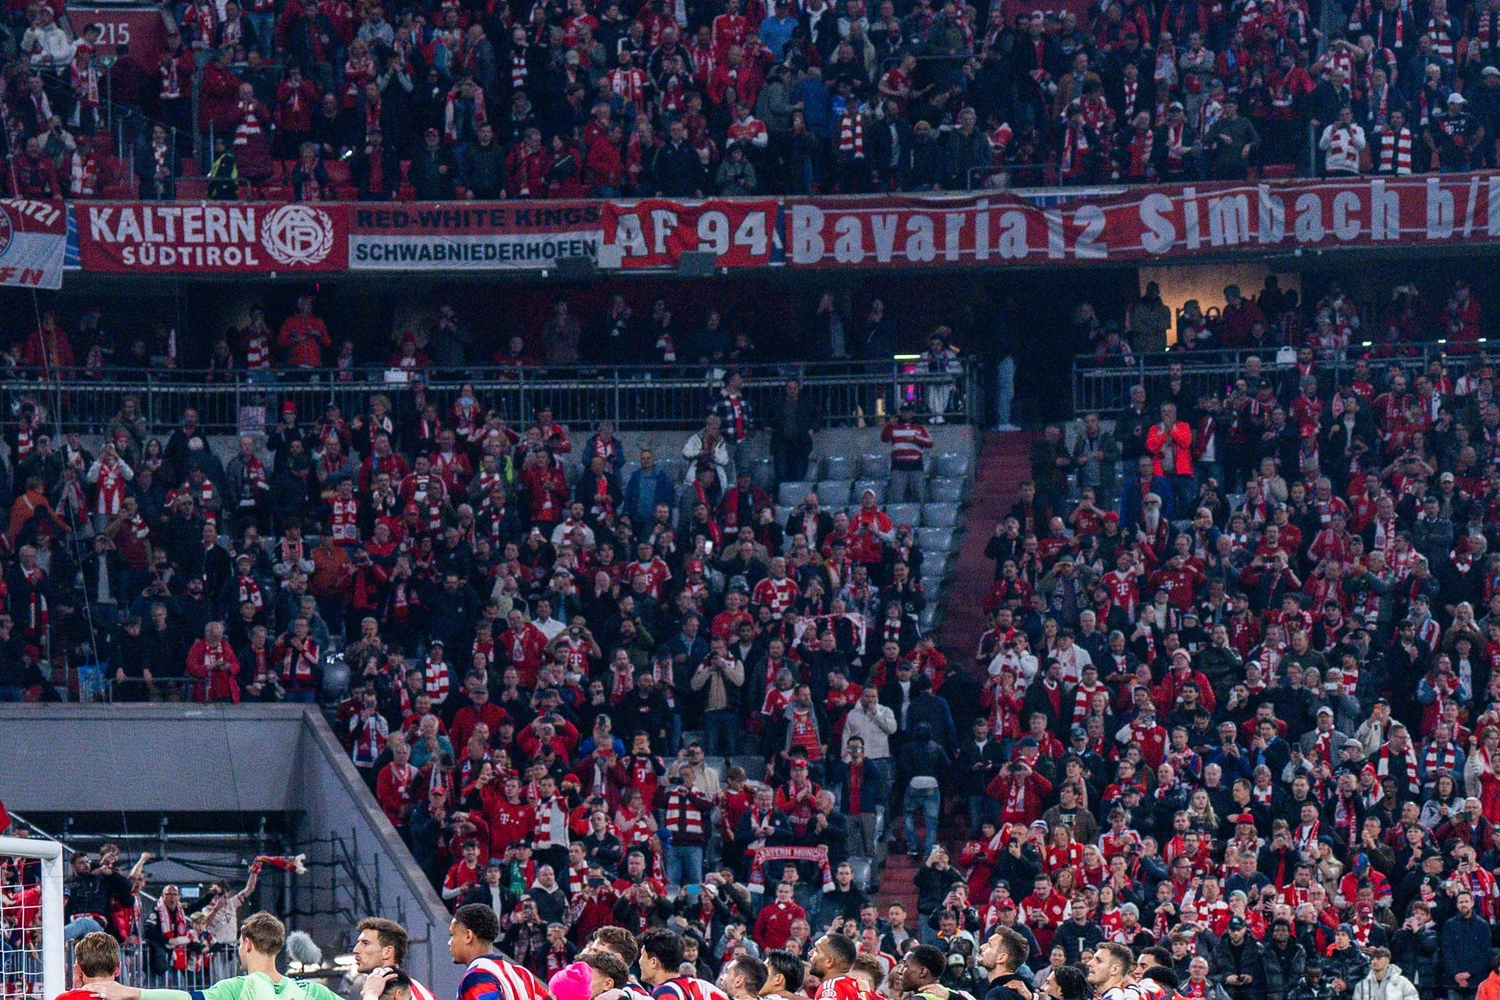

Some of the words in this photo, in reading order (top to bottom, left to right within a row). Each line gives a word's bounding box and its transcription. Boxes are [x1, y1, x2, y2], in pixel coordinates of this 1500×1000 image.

[95, 23, 130, 45] 215
[90, 206, 255, 243] KALTERN
[356, 206, 503, 231] RED-WHITE
[515, 205, 599, 228] KINGS
[791, 199, 1029, 264] Bavaria
[1140, 179, 1400, 253] Simbach
[697, 209, 767, 256] 94
[122, 243, 259, 266] SÜDTIROL
[356, 239, 597, 264] SCHWABNIEDERHOFEN
